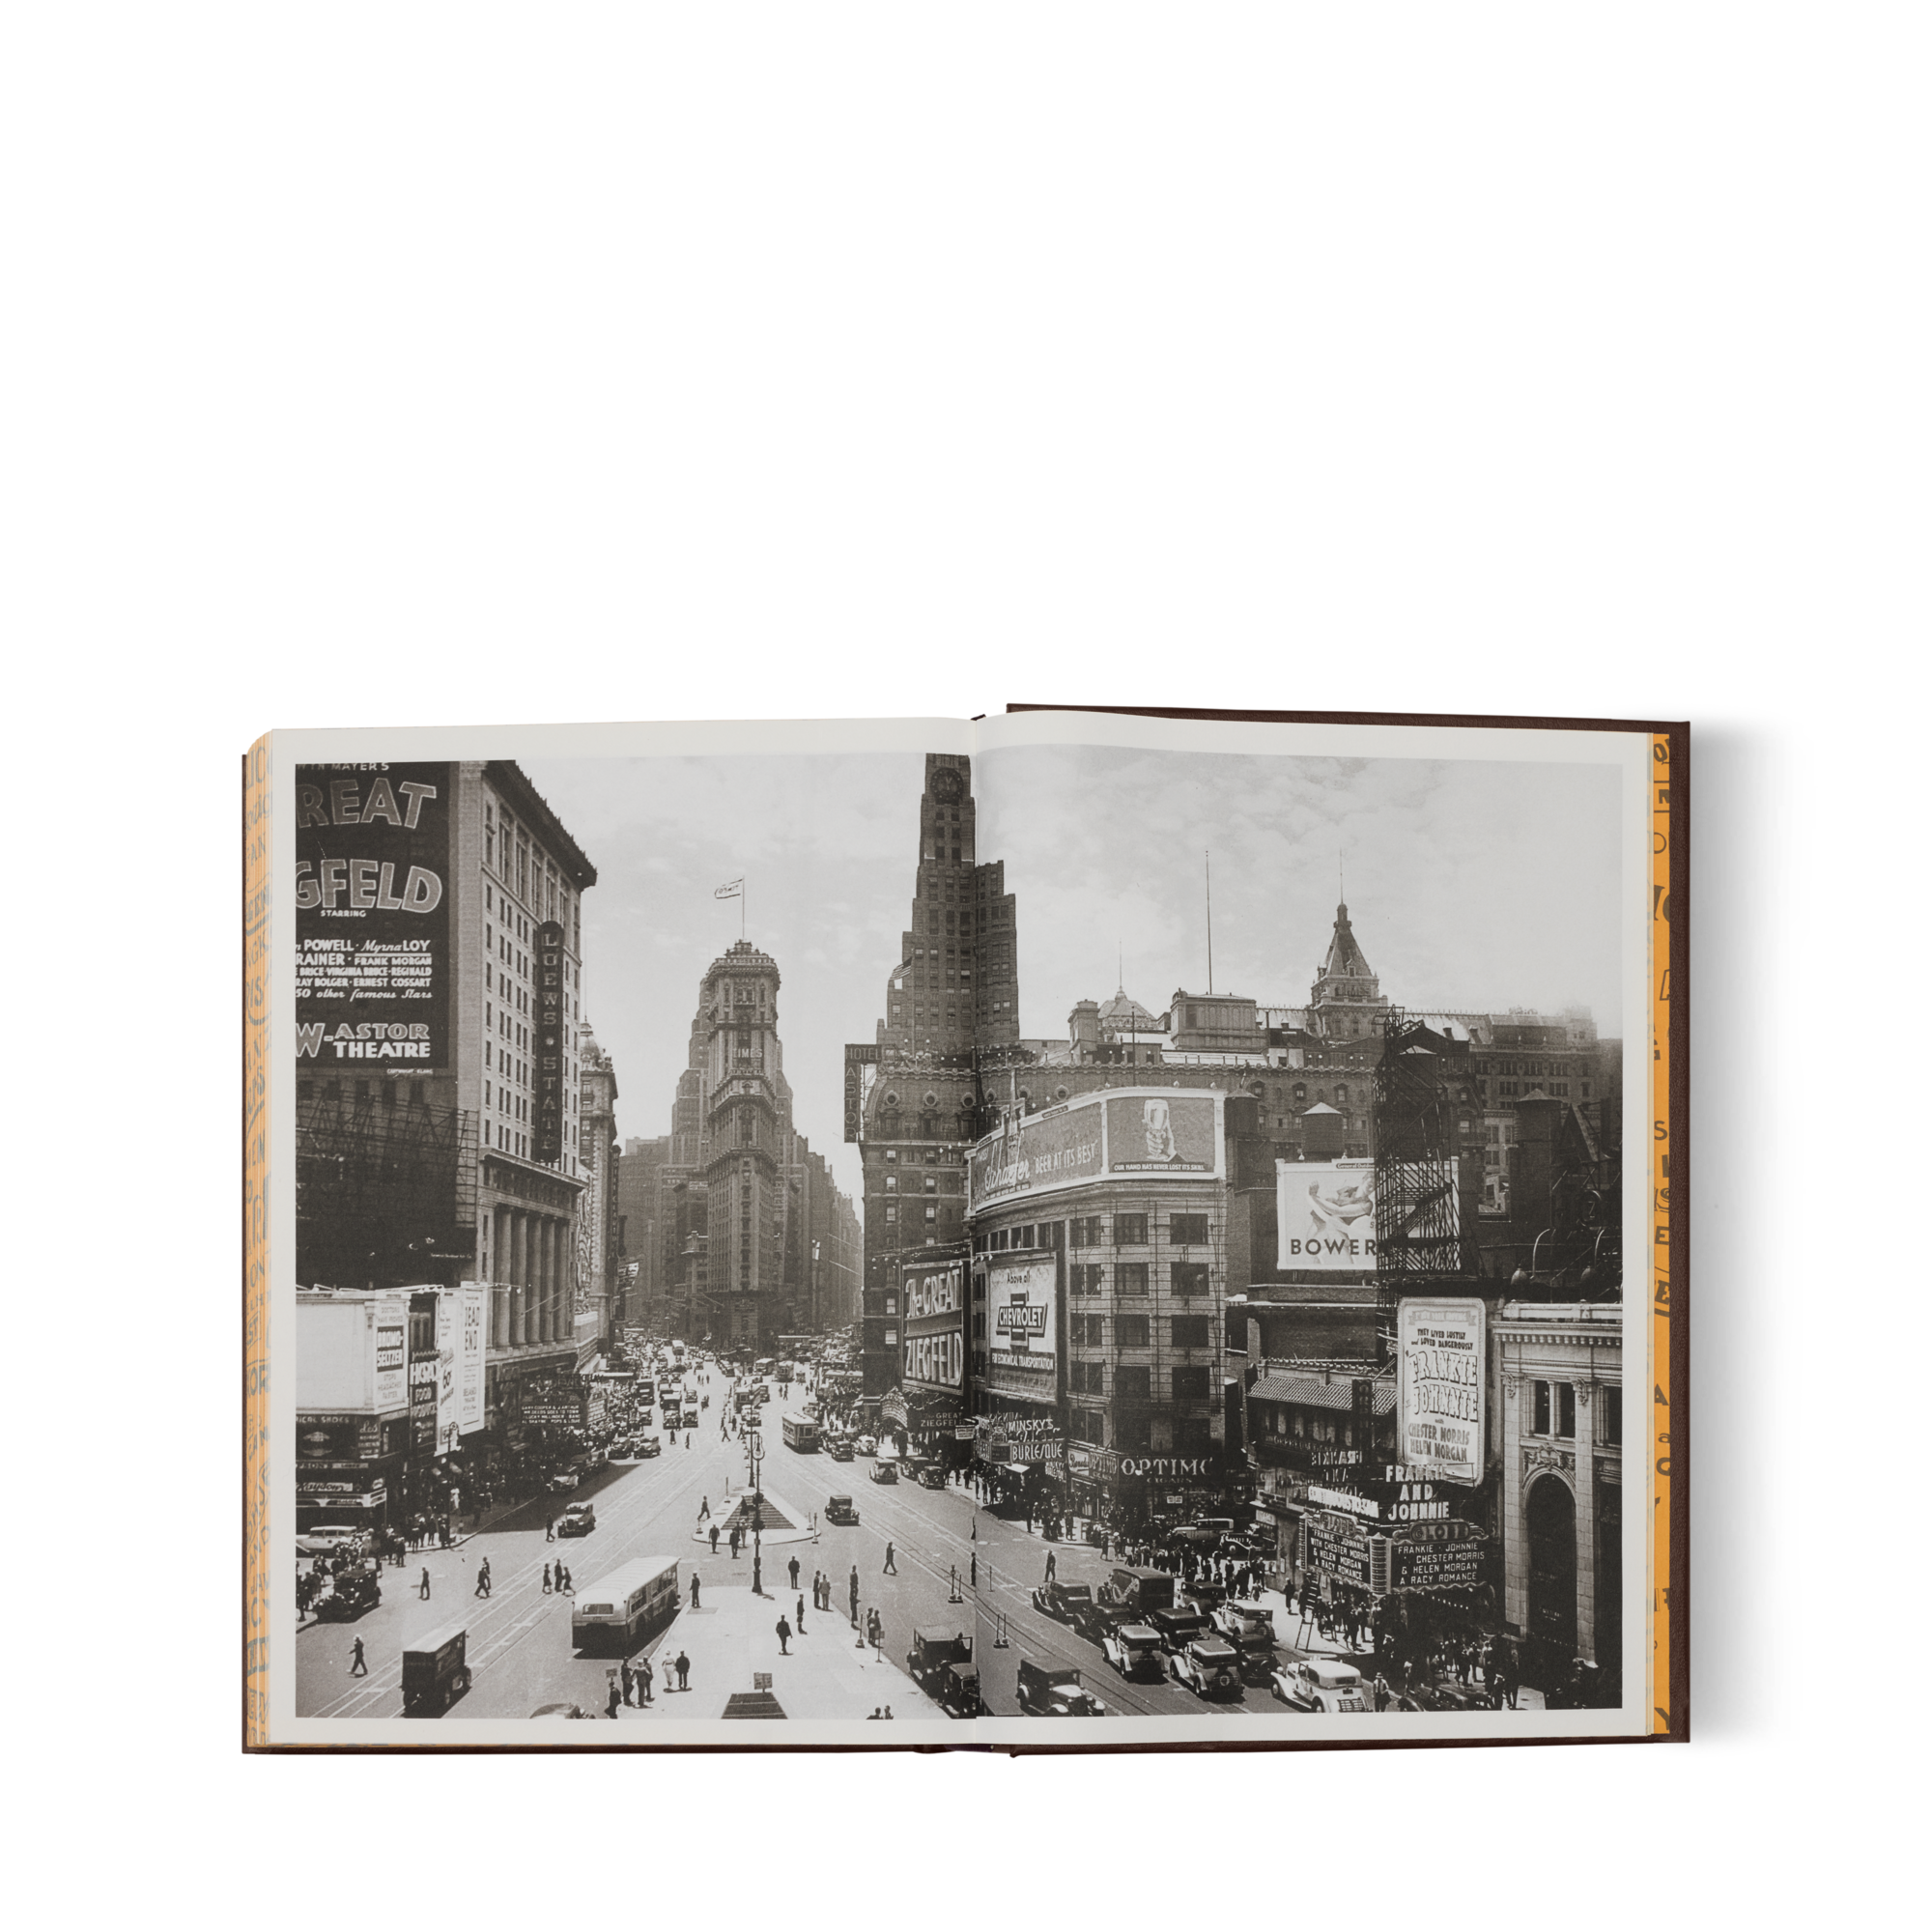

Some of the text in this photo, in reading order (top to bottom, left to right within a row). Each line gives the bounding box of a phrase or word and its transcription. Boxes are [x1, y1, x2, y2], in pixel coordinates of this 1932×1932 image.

[296, 859, 442, 913] GFELD
[304, 939, 355, 952] POWELL
[360, 940, 403, 953] Myrna
[403, 940, 431, 952] LOY
[296, 953, 345, 966] RAINER
[299, 967, 433, 976] BRICE VIRGINIA BRUCE REGINALD
[296, 978, 432, 986] RAY BOLGER ERNEST COSSART
[316, 989, 346, 998] other
[350, 988, 397, 1002] famous
[401, 988, 433, 998] Stars
[334, 1023, 430, 1039] ASTOR
[332, 1041, 431, 1058] THEATRE
[733, 1048, 762, 1058] TIMES
[845, 1047, 881, 1061] HOTEL
[845, 1066, 857, 1140] ASTOR
[1291, 1238, 1377, 1256] BOWER
[1007, 1271, 1021, 1285] Above
[923, 1268, 960, 1316] GREAT
[999, 1307, 1042, 1327] CHEVROLET
[1431, 1329, 1444, 1338] LIVED
[1447, 1330, 1465, 1340] LUSTILY
[1421, 1338, 1435, 1347] LOVED
[1438, 1340, 1473, 1350] DANGEROUSLY
[905, 1332, 963, 1386] ZIEGFELD
[1408, 1350, 1478, 1387] FRANKIE
[1408, 1423, 1470, 1446] CHESTER MORRIS
[1012, 1443, 1062, 1461] BURLESQUE
[1410, 1438, 1467, 1463] HELEN MORGAN
[1386, 1464, 1445, 1483] FRANKIE
[1400, 1485, 1434, 1501] AND
[1387, 1501, 1450, 1521] JOHNNIE
[1324, 1542, 1347, 1556] CHESTER
[1350, 1549, 1369, 1562] MORRIS
[1398, 1542, 1479, 1554] FRANKIE JOHNNIE
[1320, 1549, 1336, 1561] HELEN
[1340, 1556, 1362, 1570] MORGAN
[1416, 1551, 1485, 1564] CHESTER MORRIS
[1321, 1559, 1335, 1571] RACY
[1338, 1565, 1363, 1580] ROMANCE
[1413, 1565, 1439, 1574] HELEN
[1444, 1562, 1478, 1572] MORGAN
[1411, 1575, 1433, 1584] RACY
[1439, 1572, 1477, 1582] ROMANCE
